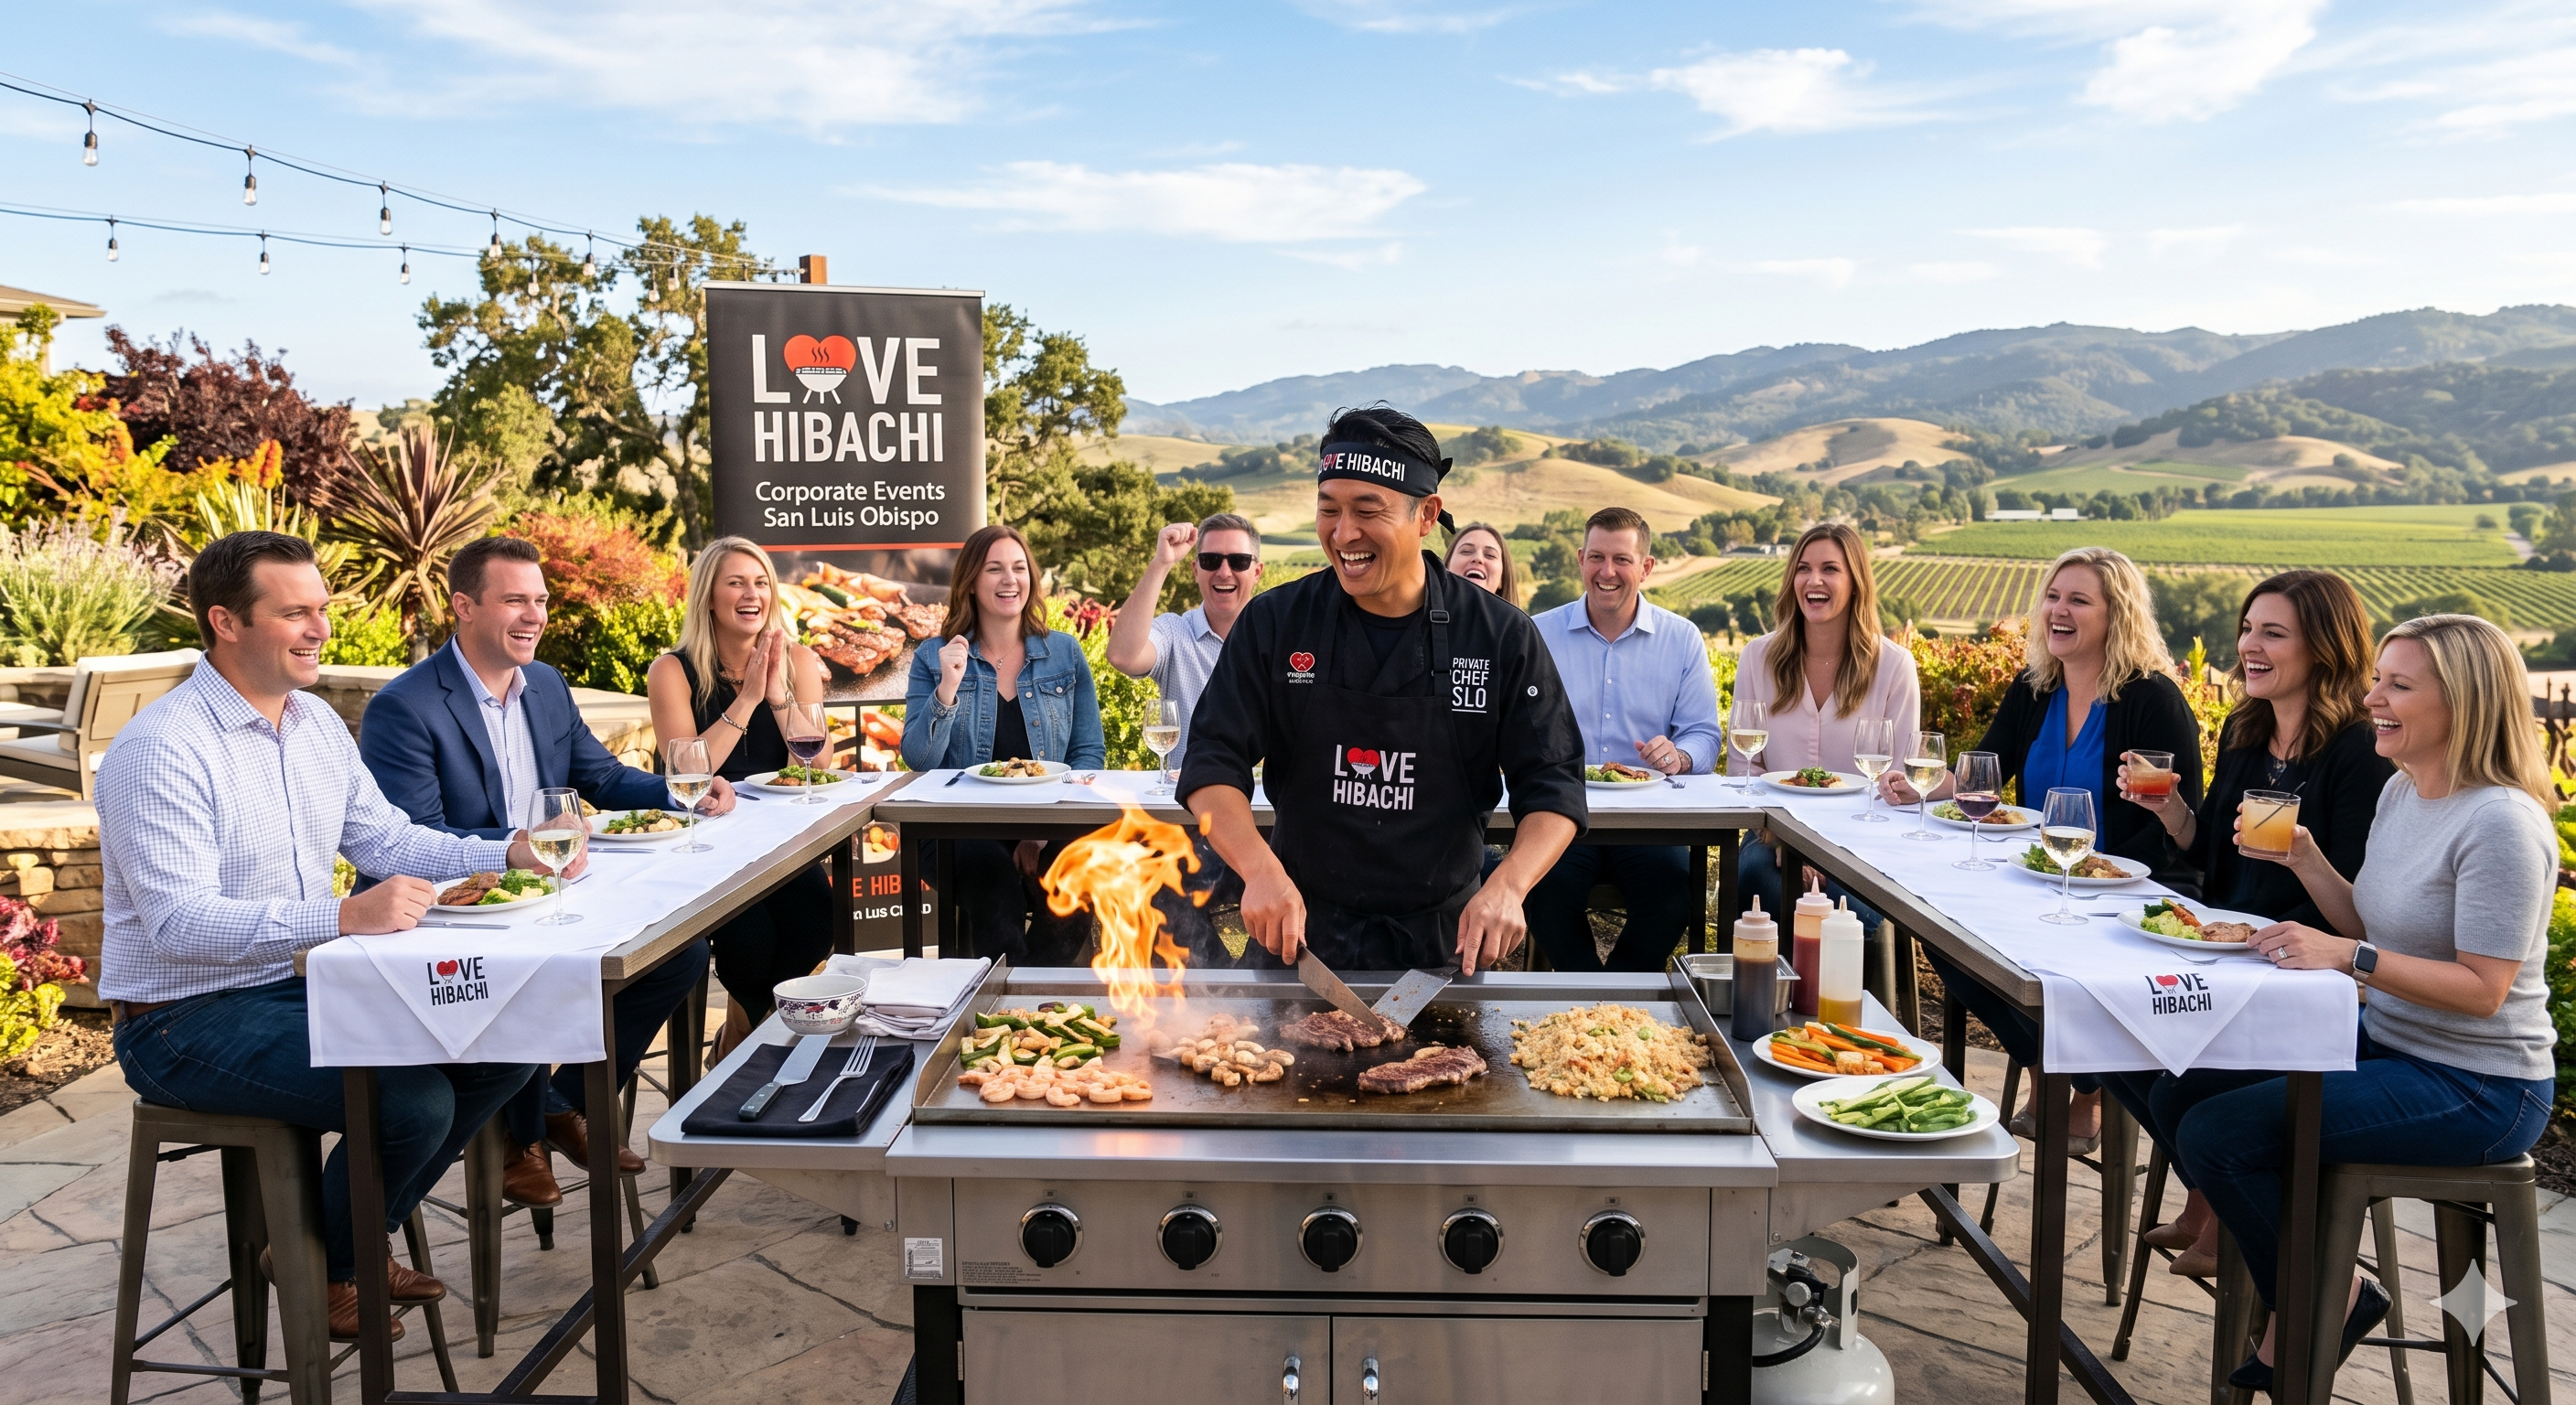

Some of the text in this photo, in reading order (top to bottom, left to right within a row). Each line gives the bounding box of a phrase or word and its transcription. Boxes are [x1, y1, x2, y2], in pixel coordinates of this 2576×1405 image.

[754, 411, 944, 463] HIBACHI
[1347, 453, 1405, 482] HIBACHI
[755, 481, 946, 506] Corporate Events
[764, 506, 939, 531] San Luis Obispo
[1452, 657, 1490, 670] PRIVATE
[1452, 669, 1489, 686] CHEF
[1452, 686, 1487, 709] SLO
[1333, 778, 1414, 810] HIBACHI
[430, 981, 489, 1006] HIBACHI
[2152, 992, 2212, 1015] HIBACHI
